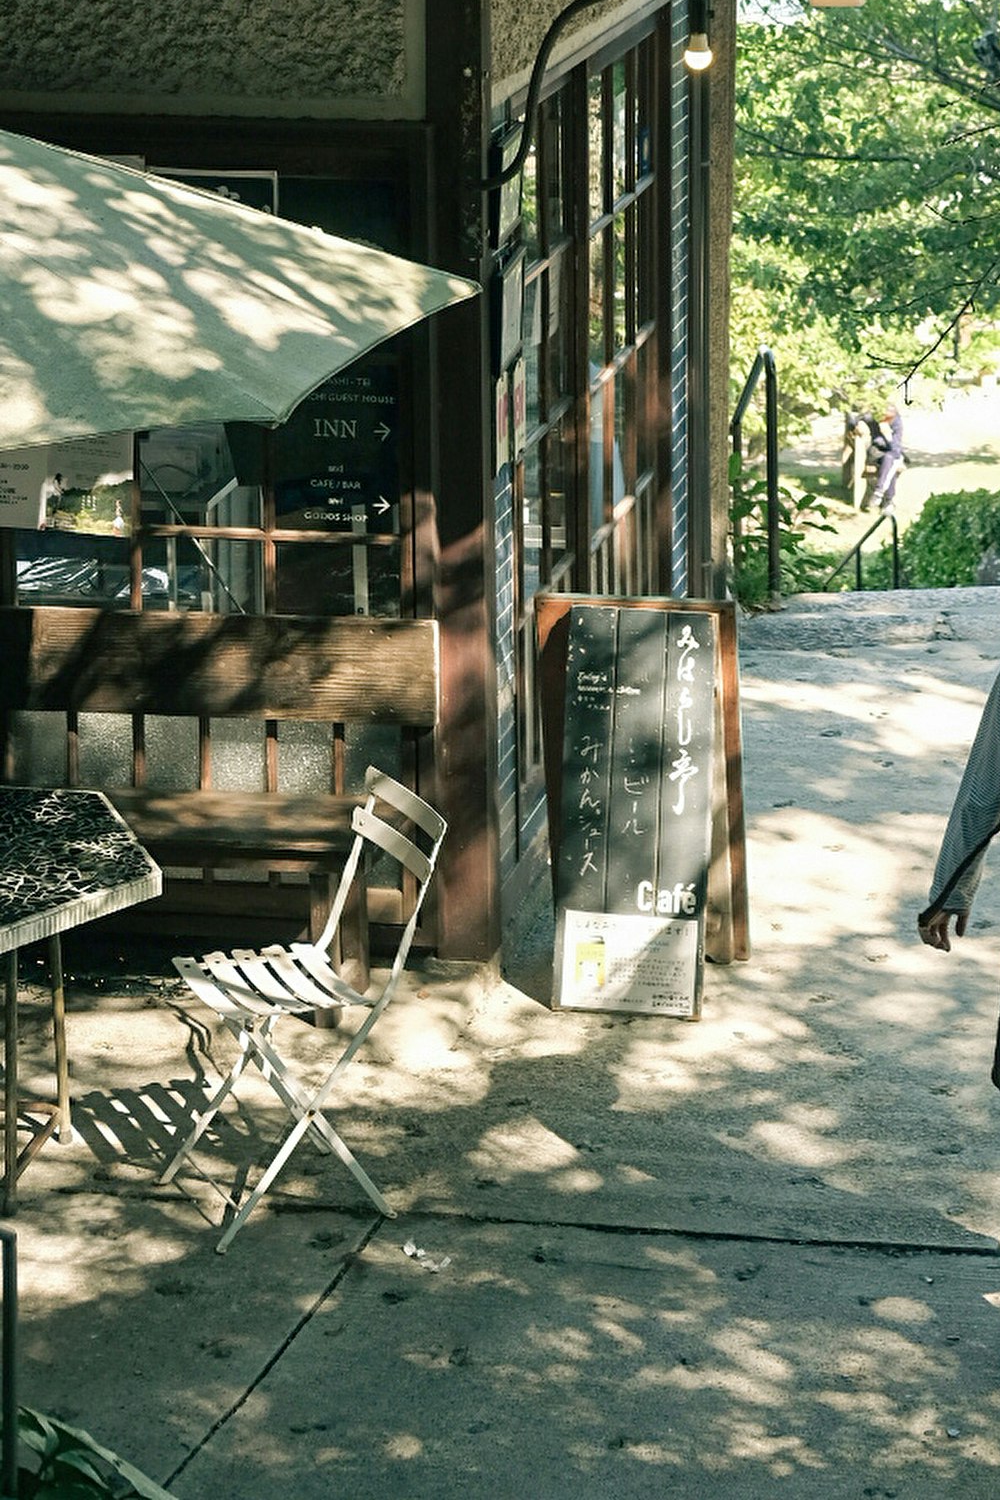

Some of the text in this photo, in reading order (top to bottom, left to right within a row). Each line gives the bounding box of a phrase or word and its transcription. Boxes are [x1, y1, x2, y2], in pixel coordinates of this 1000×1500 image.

[313, 418, 358, 438] INN
[621, 775, 650, 834] ビール
[637, 879, 697, 915] Café
